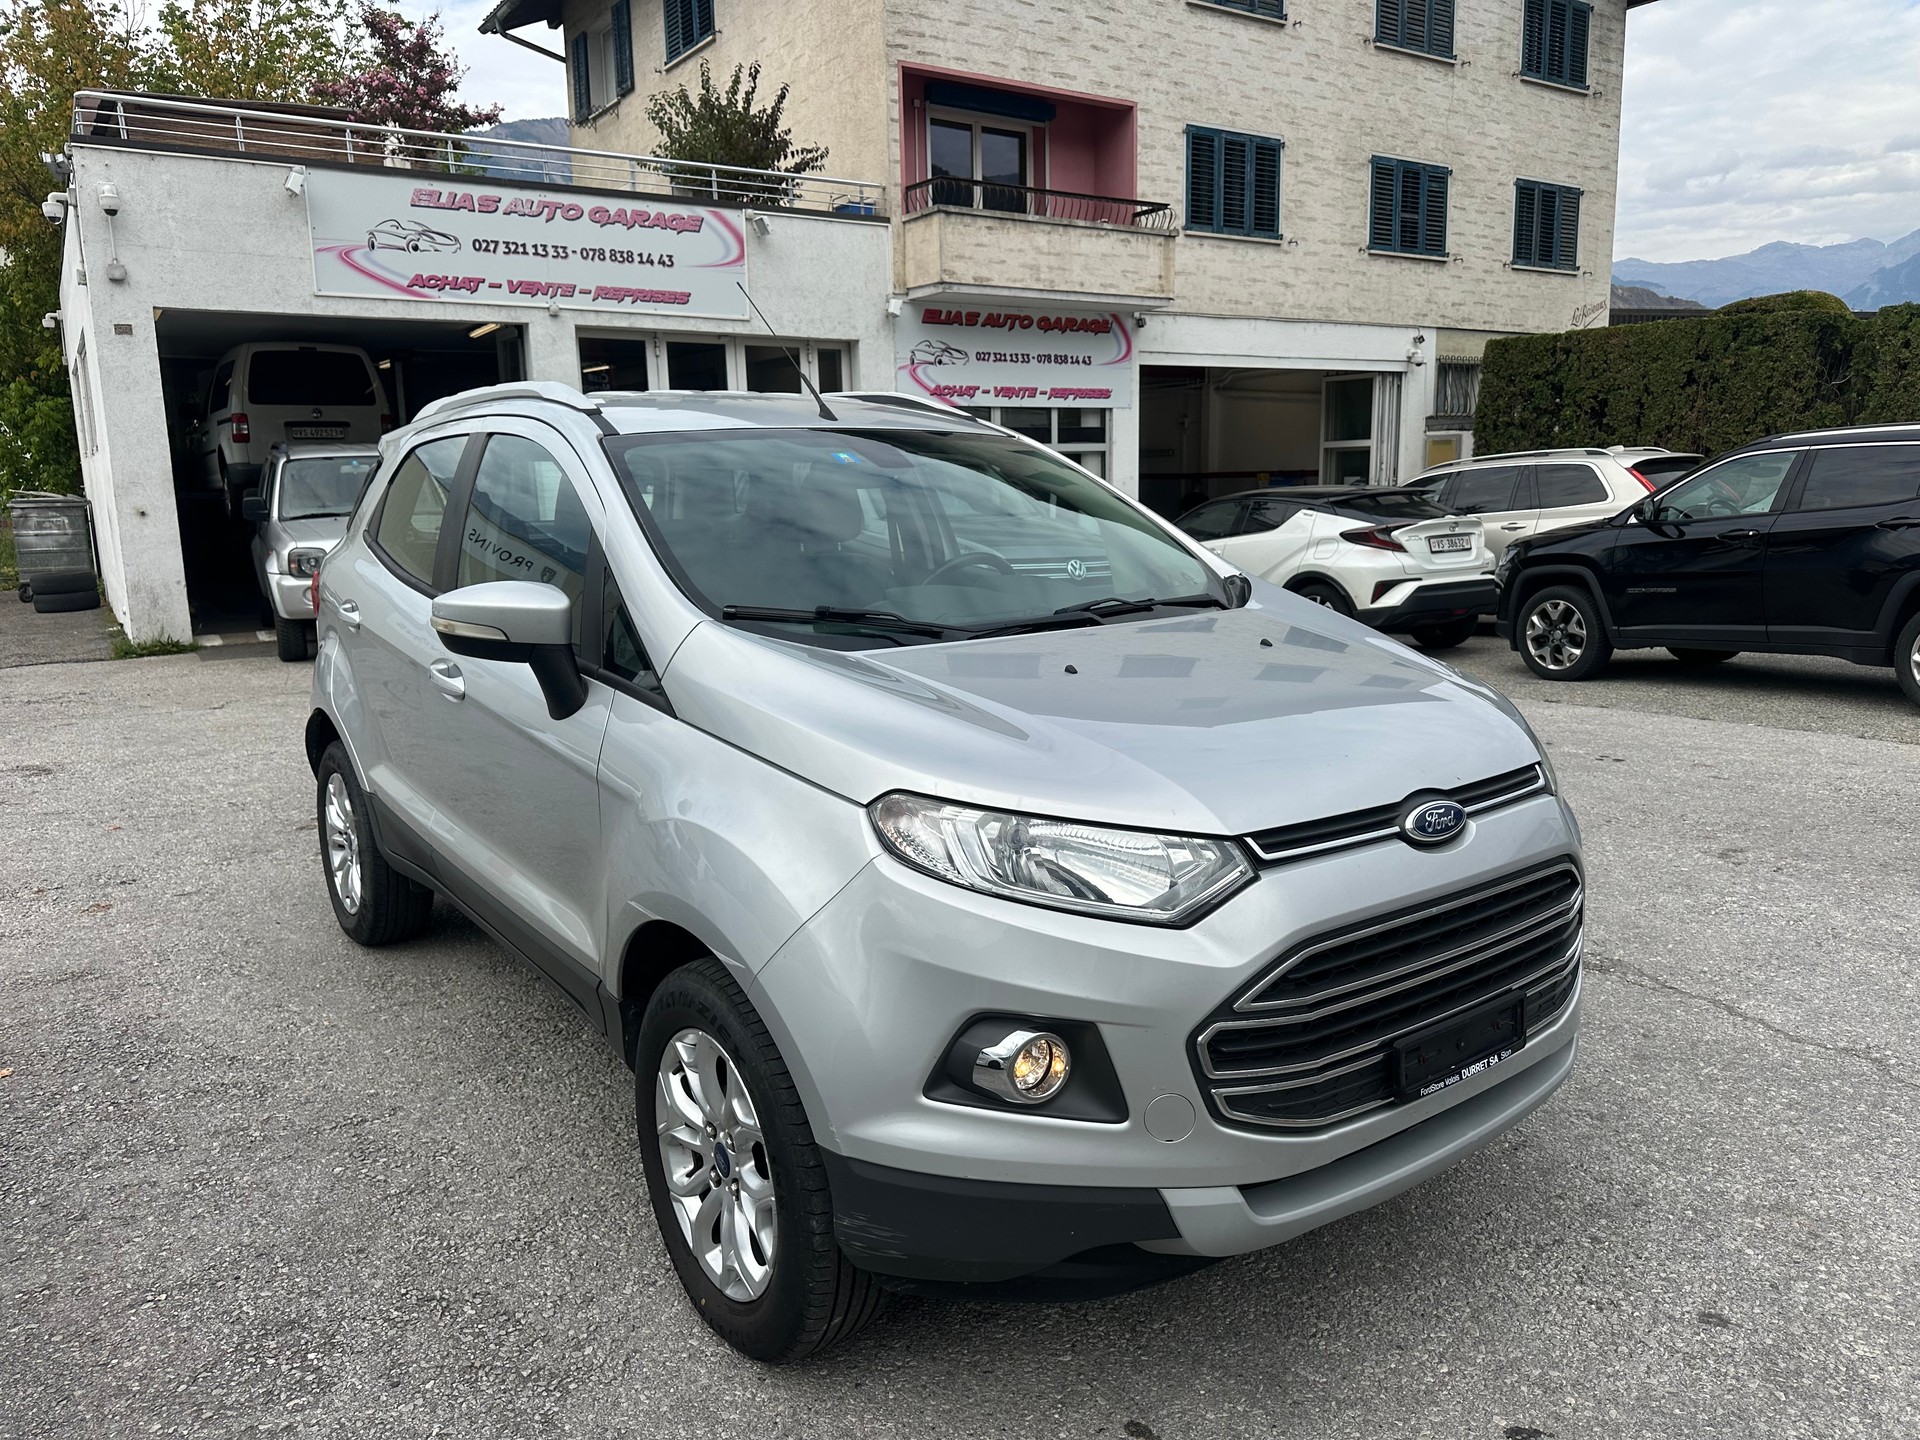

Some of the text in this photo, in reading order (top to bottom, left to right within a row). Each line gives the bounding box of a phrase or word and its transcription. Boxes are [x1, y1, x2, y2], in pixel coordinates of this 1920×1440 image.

[410, 188, 704, 235] ELIAS AUTO GARAGE
[472, 239, 499, 254] 027
[502, 240, 529, 256] 321
[532, 243, 549, 258] 13
[551, 245, 568, 260] 33
[580, 248, 606, 262] 078
[609, 249, 634, 264] 838
[637, 252, 654, 266] 14
[657, 254, 674, 268] 43
[407, 274, 485, 294] ACHAT
[507, 280, 576, 299] VENTE
[592, 286, 692, 305] REPRISES
[922, 308, 1113, 336] ELIAS AUTO GARAGE
[975, 351, 991, 362] 027
[993, 352, 1008, 363] 321
[1009, 353, 1019, 363] 13
[1020, 353, 1031, 364] 33
[1036, 354, 1052, 364] 078
[1053, 354, 1069, 365] 838
[1069, 355, 1080, 365] 14
[1081, 356, 1092, 366] 43
[930, 384, 980, 399] ACHAT
[993, 386, 1038, 400] VENTE
[1047, 387, 1113, 401] REPRISES
[1425, 808, 1456, 832] Ford
[1420, 1049, 1512, 1097] FordStore Valais DURRET SA Sion
